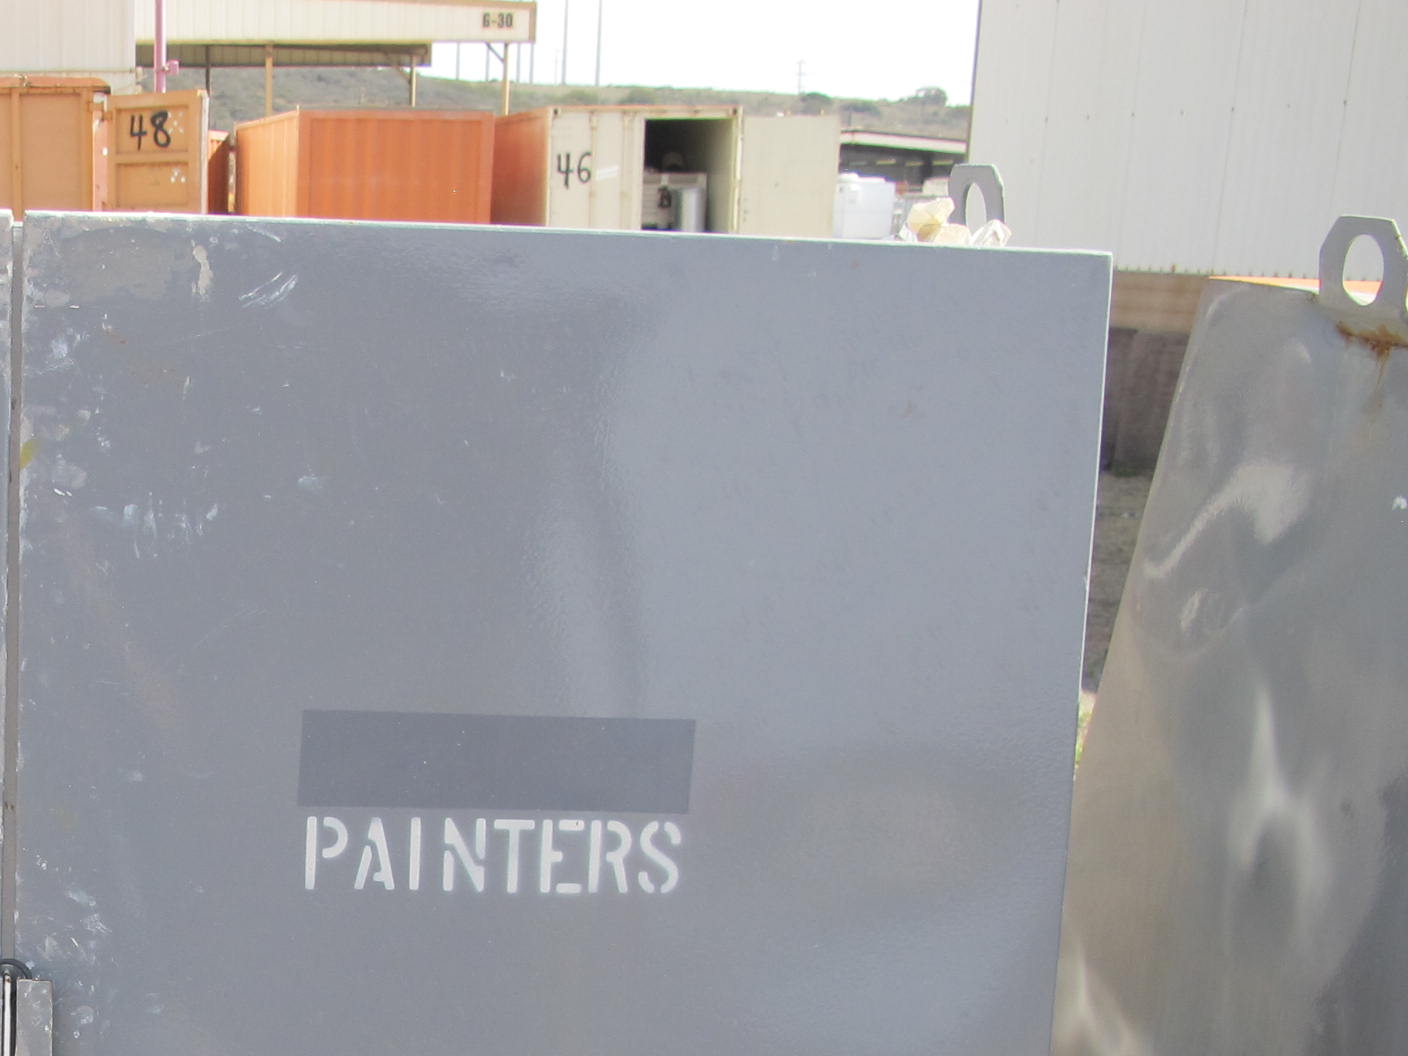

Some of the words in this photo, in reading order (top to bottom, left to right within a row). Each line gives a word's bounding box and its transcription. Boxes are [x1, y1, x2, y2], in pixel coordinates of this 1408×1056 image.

[130, 110, 171, 152] 48
[557, 151, 592, 190] 46
[304, 816, 682, 894] PAINTERS
